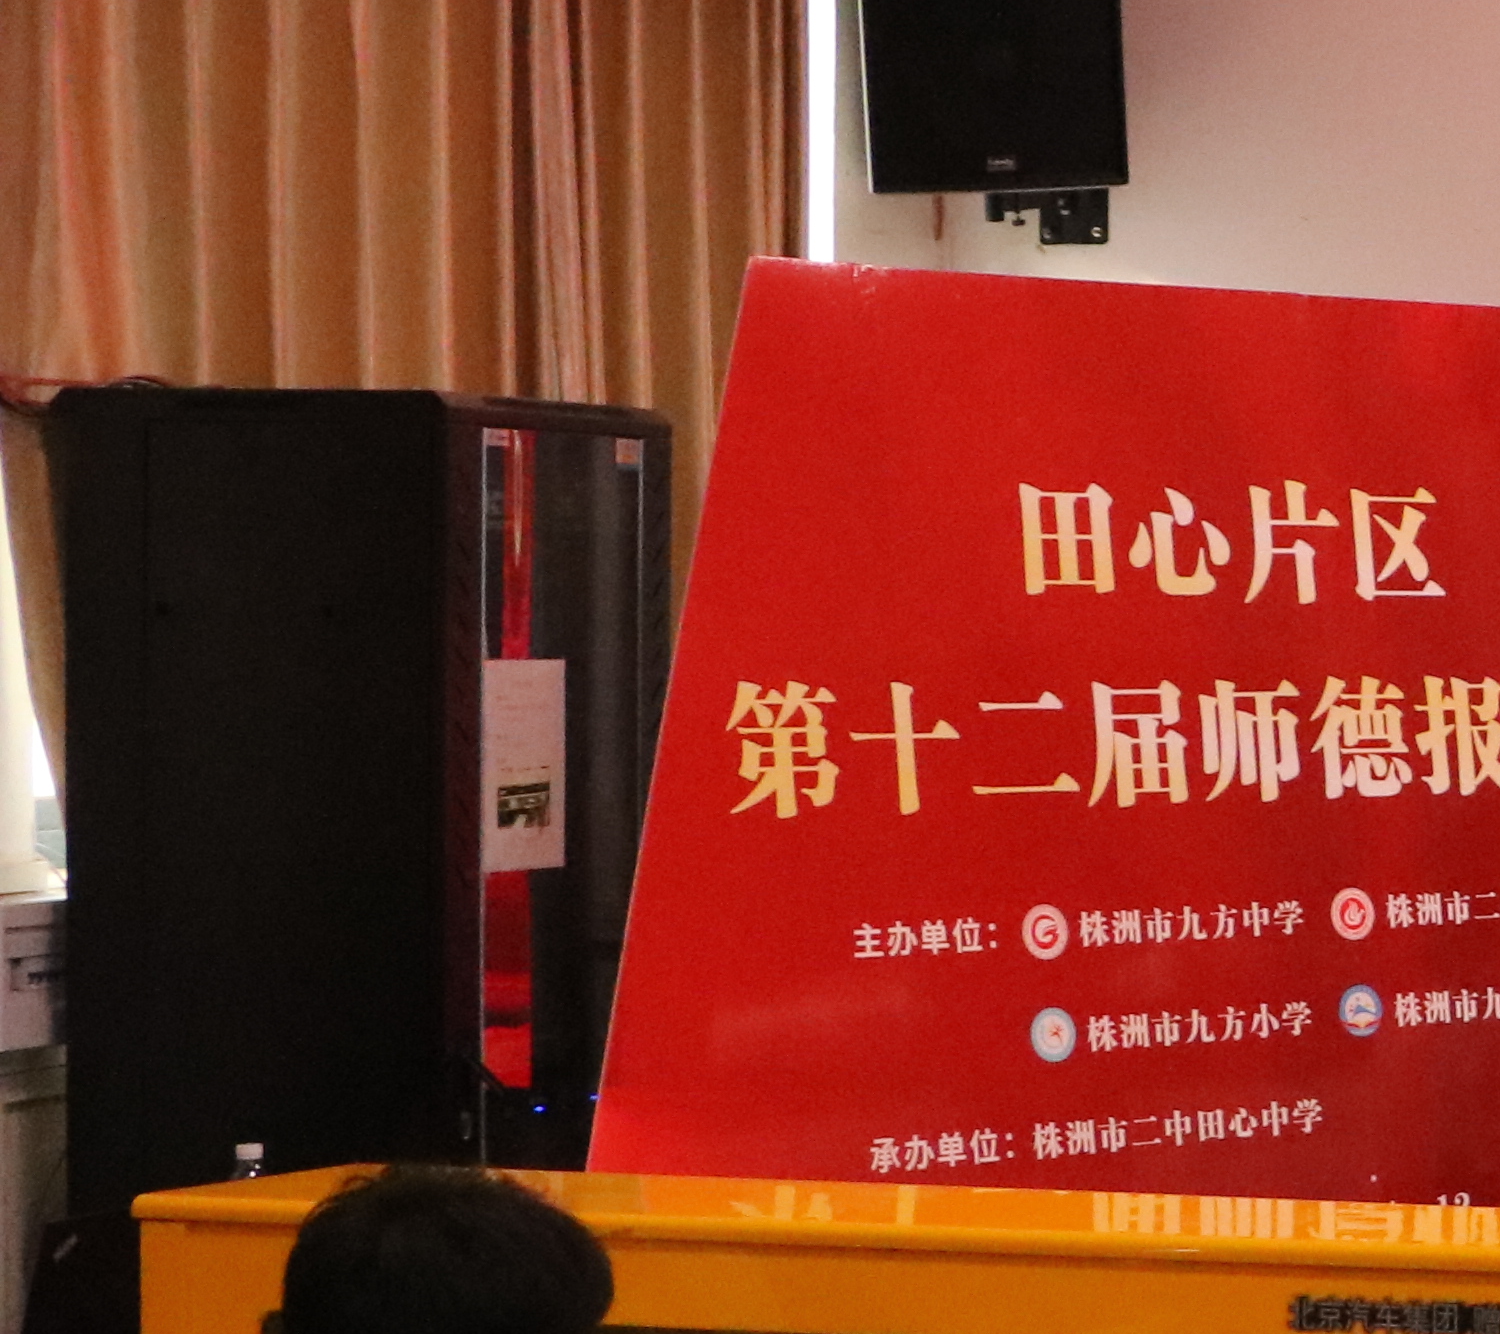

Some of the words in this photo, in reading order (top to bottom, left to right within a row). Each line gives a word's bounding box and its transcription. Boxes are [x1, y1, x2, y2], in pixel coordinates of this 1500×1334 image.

[1018, 481, 1448, 605] 田心片区
[1078, 901, 1305, 951] 株洲市九方中学
[1087, 1001, 1312, 1054] 株洲市九方小学
